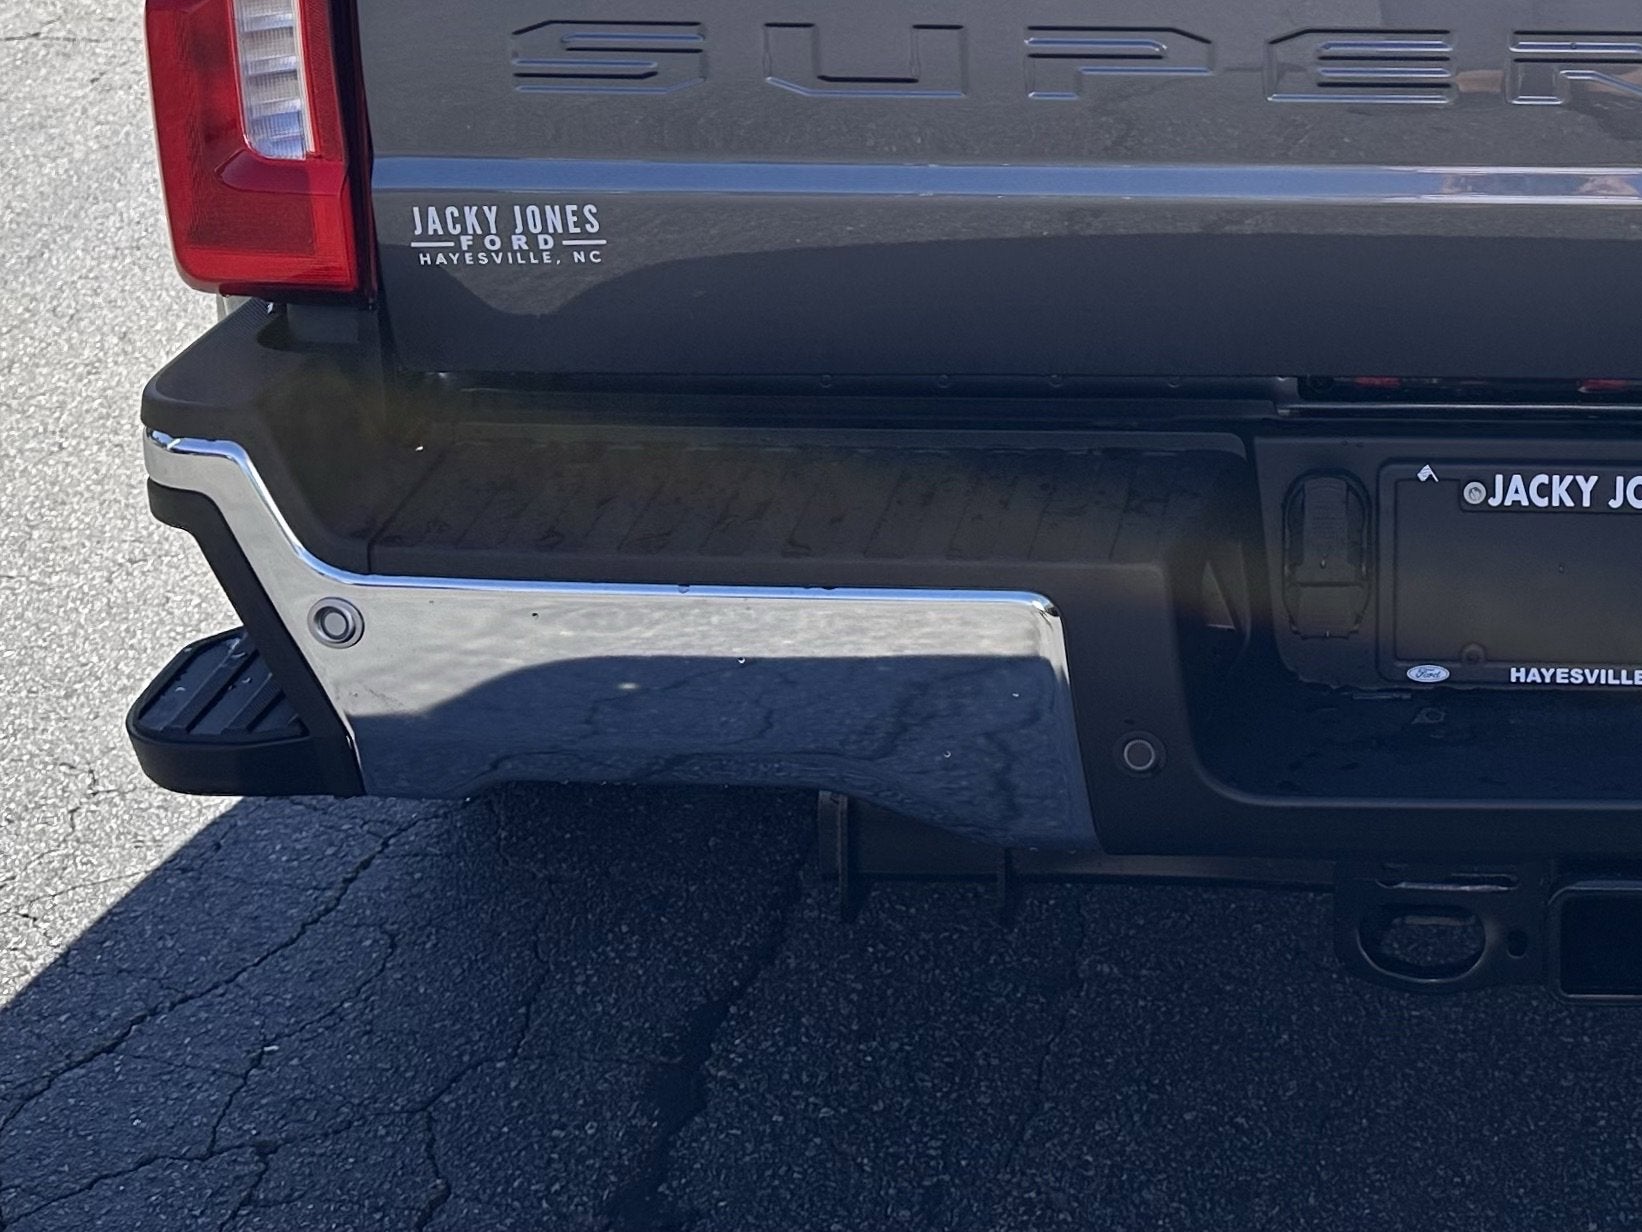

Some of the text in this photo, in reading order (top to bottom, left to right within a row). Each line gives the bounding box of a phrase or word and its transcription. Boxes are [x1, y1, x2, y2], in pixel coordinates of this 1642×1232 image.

[412, 203, 600, 236] JACKY JONES
[459, 234, 555, 251] FORD
[418, 250, 602, 265] HAYESVILLE, NC
[1487, 473, 1598, 508] JACKY
